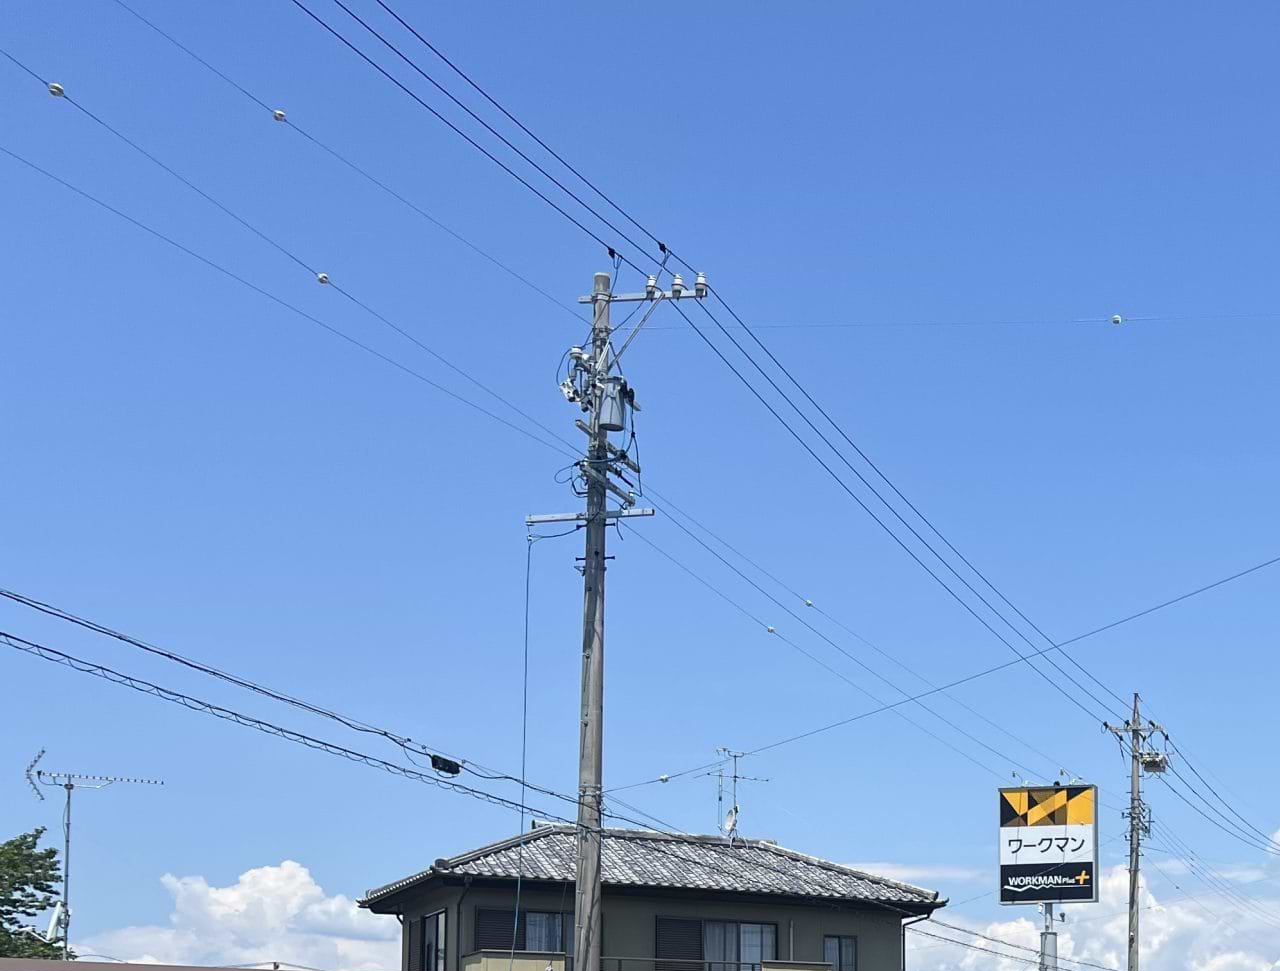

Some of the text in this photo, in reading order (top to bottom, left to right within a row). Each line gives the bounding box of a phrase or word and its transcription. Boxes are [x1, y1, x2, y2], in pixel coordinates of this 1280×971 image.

[1008, 837, 1085, 854] ワークマン
[1008, 875, 1062, 886] WORKMAN
